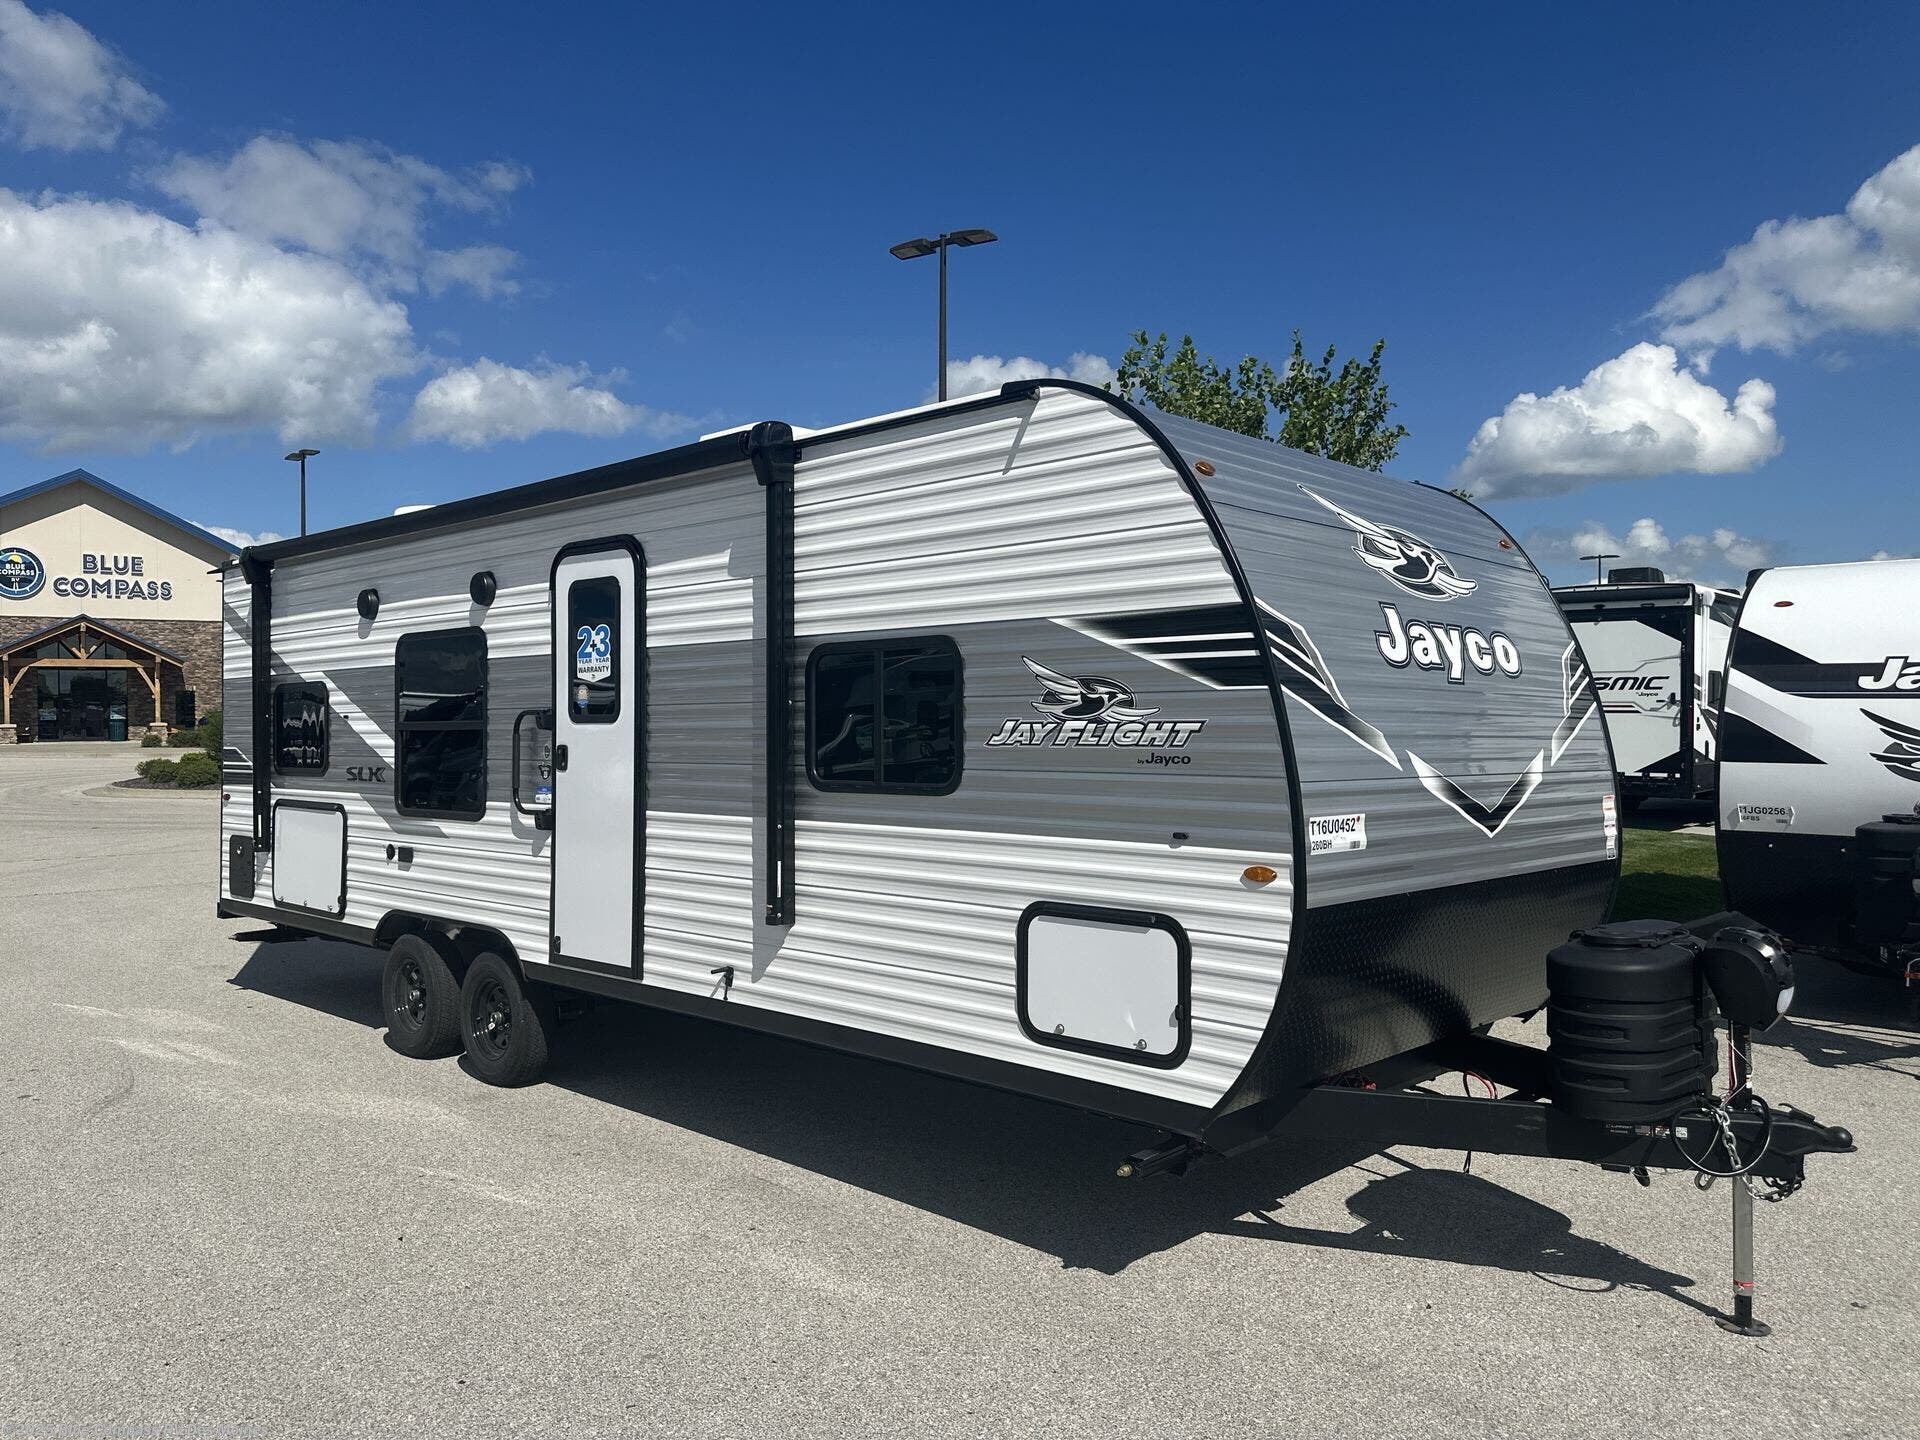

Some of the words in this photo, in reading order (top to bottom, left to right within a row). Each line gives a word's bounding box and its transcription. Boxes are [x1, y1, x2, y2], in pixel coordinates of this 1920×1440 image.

[82, 553, 144, 577] BLUE
[53, 576, 173, 601] COMPASS
[1373, 601, 1523, 685] Jayco
[578, 665, 610, 674] WARRANTY
[985, 718, 1057, 747] JAY
[1051, 718, 1208, 748] FLIGHT
[1146, 753, 1191, 767] Jayco
[345, 766, 386, 783] SLK
[1310, 817, 1356, 836] T16U0452
